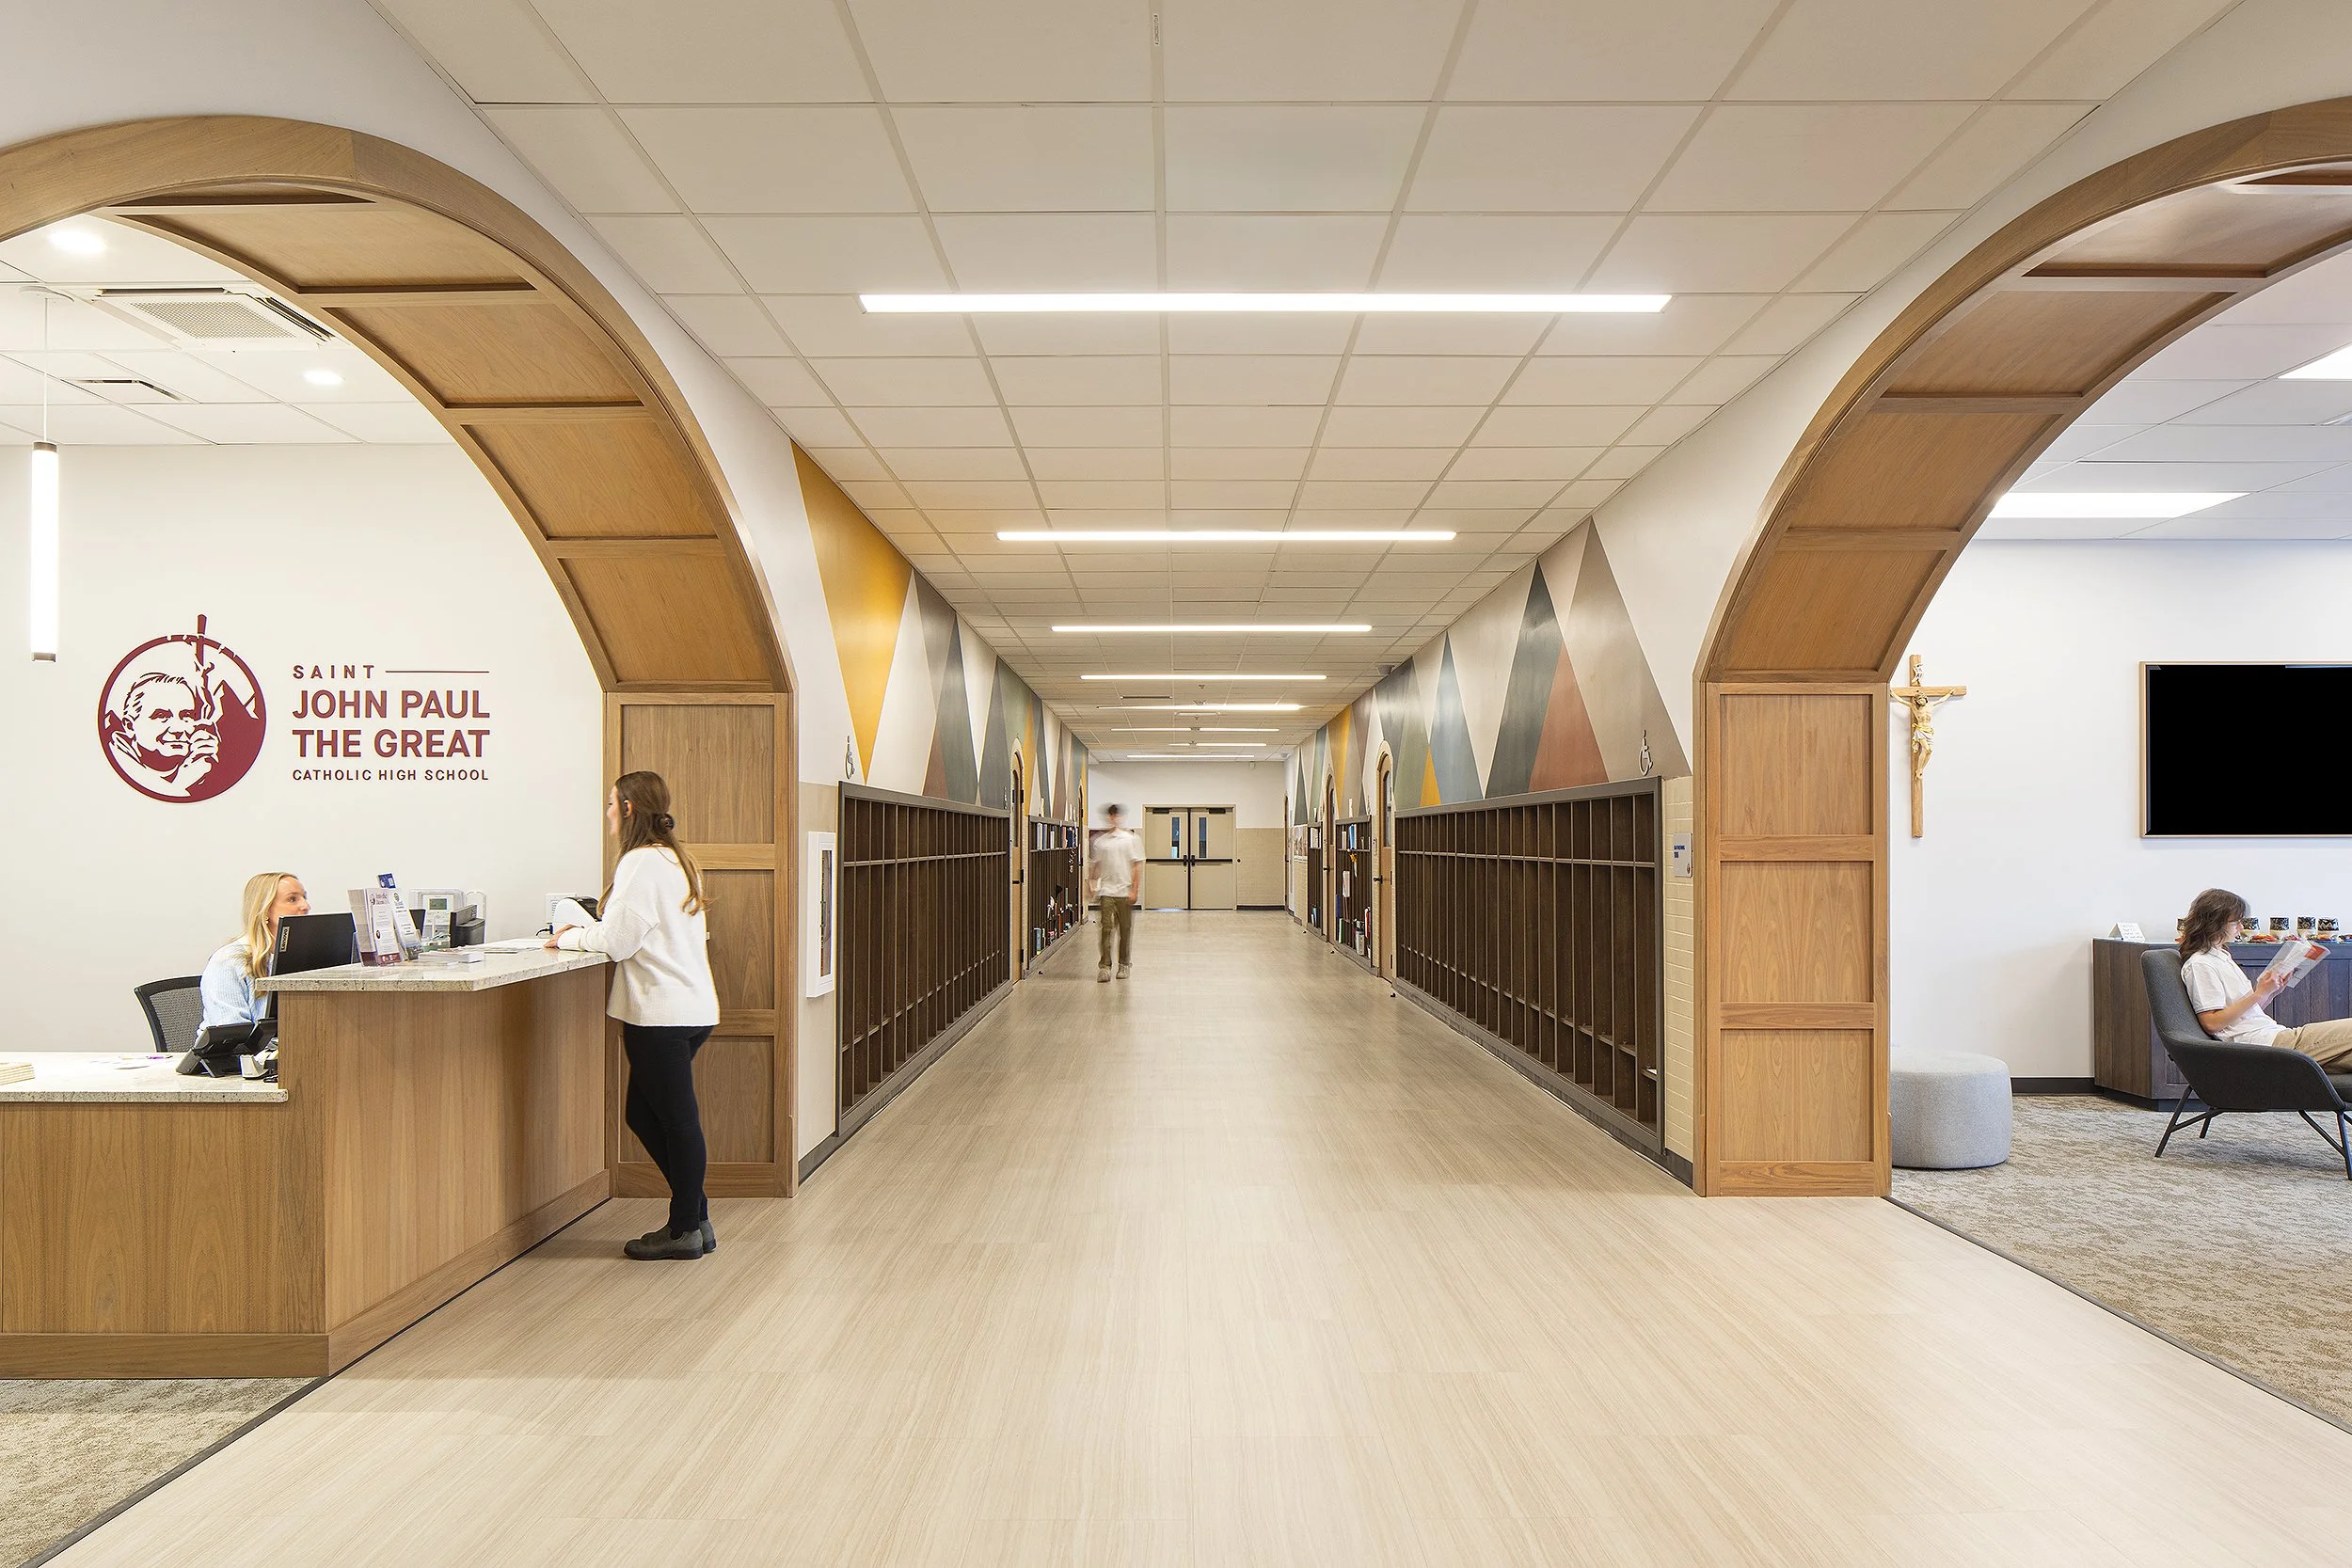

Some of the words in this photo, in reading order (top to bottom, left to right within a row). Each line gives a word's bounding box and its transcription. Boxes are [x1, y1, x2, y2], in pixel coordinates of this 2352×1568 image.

[292, 664, 374, 679] SAINT
[292, 689, 387, 719] JOHN
[401, 689, 490, 719] PAUL
[292, 728, 361, 757] THE
[373, 728, 490, 757] GREAT
[292, 768, 372, 782] CATHOLIC
[378, 768, 417, 782] HIGH
[423, 768, 489, 782] SCHOOL
